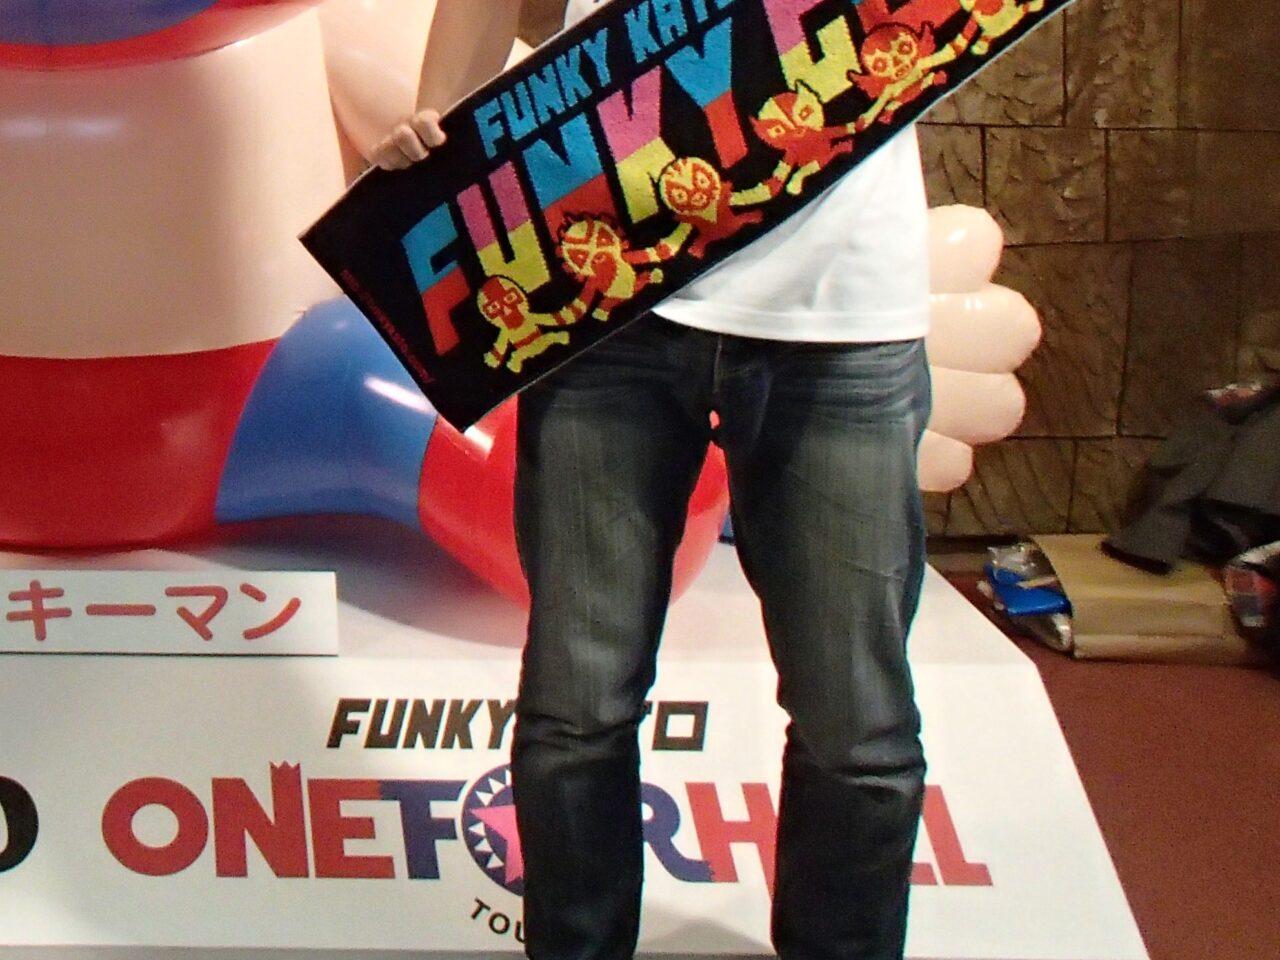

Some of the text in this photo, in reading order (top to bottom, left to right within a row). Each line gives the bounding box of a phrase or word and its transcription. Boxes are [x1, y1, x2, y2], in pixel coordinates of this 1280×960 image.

[474, 28, 613, 159] FUNKY
[399, 17, 749, 356] FUNKY
[326, 698, 517, 749] FUNKY
